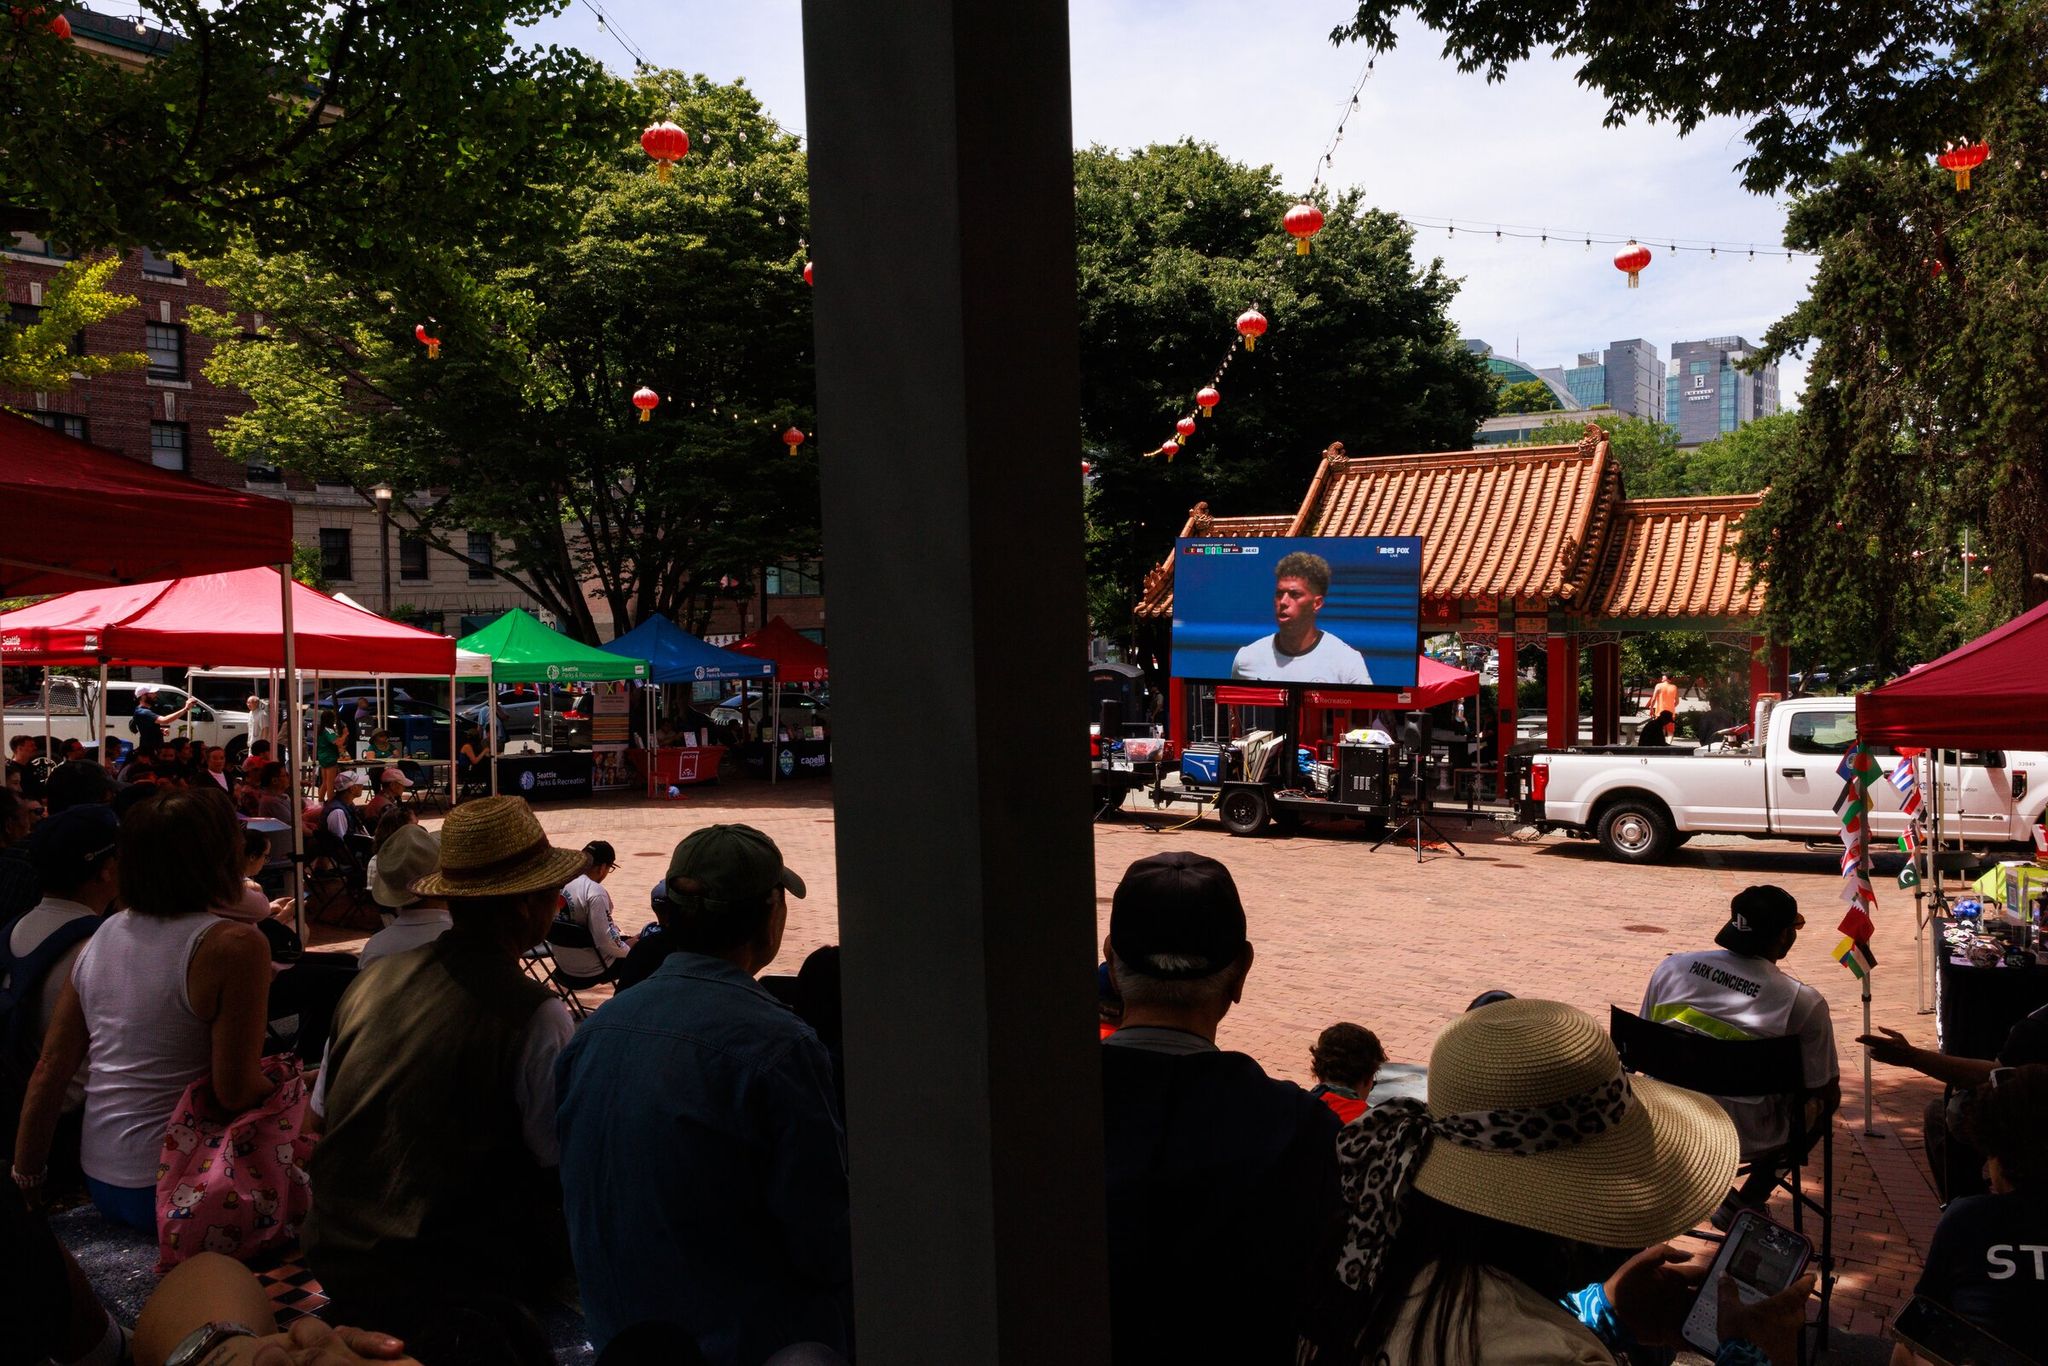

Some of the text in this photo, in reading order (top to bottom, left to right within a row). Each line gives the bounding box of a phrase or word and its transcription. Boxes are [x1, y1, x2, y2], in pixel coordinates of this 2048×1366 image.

[800, 754, 825, 766] capelli
[537, 770, 557, 779] Seattle
[1689, 961, 1762, 998] PARK CONCIERGE
[1986, 1243, 2048, 1280] ST
